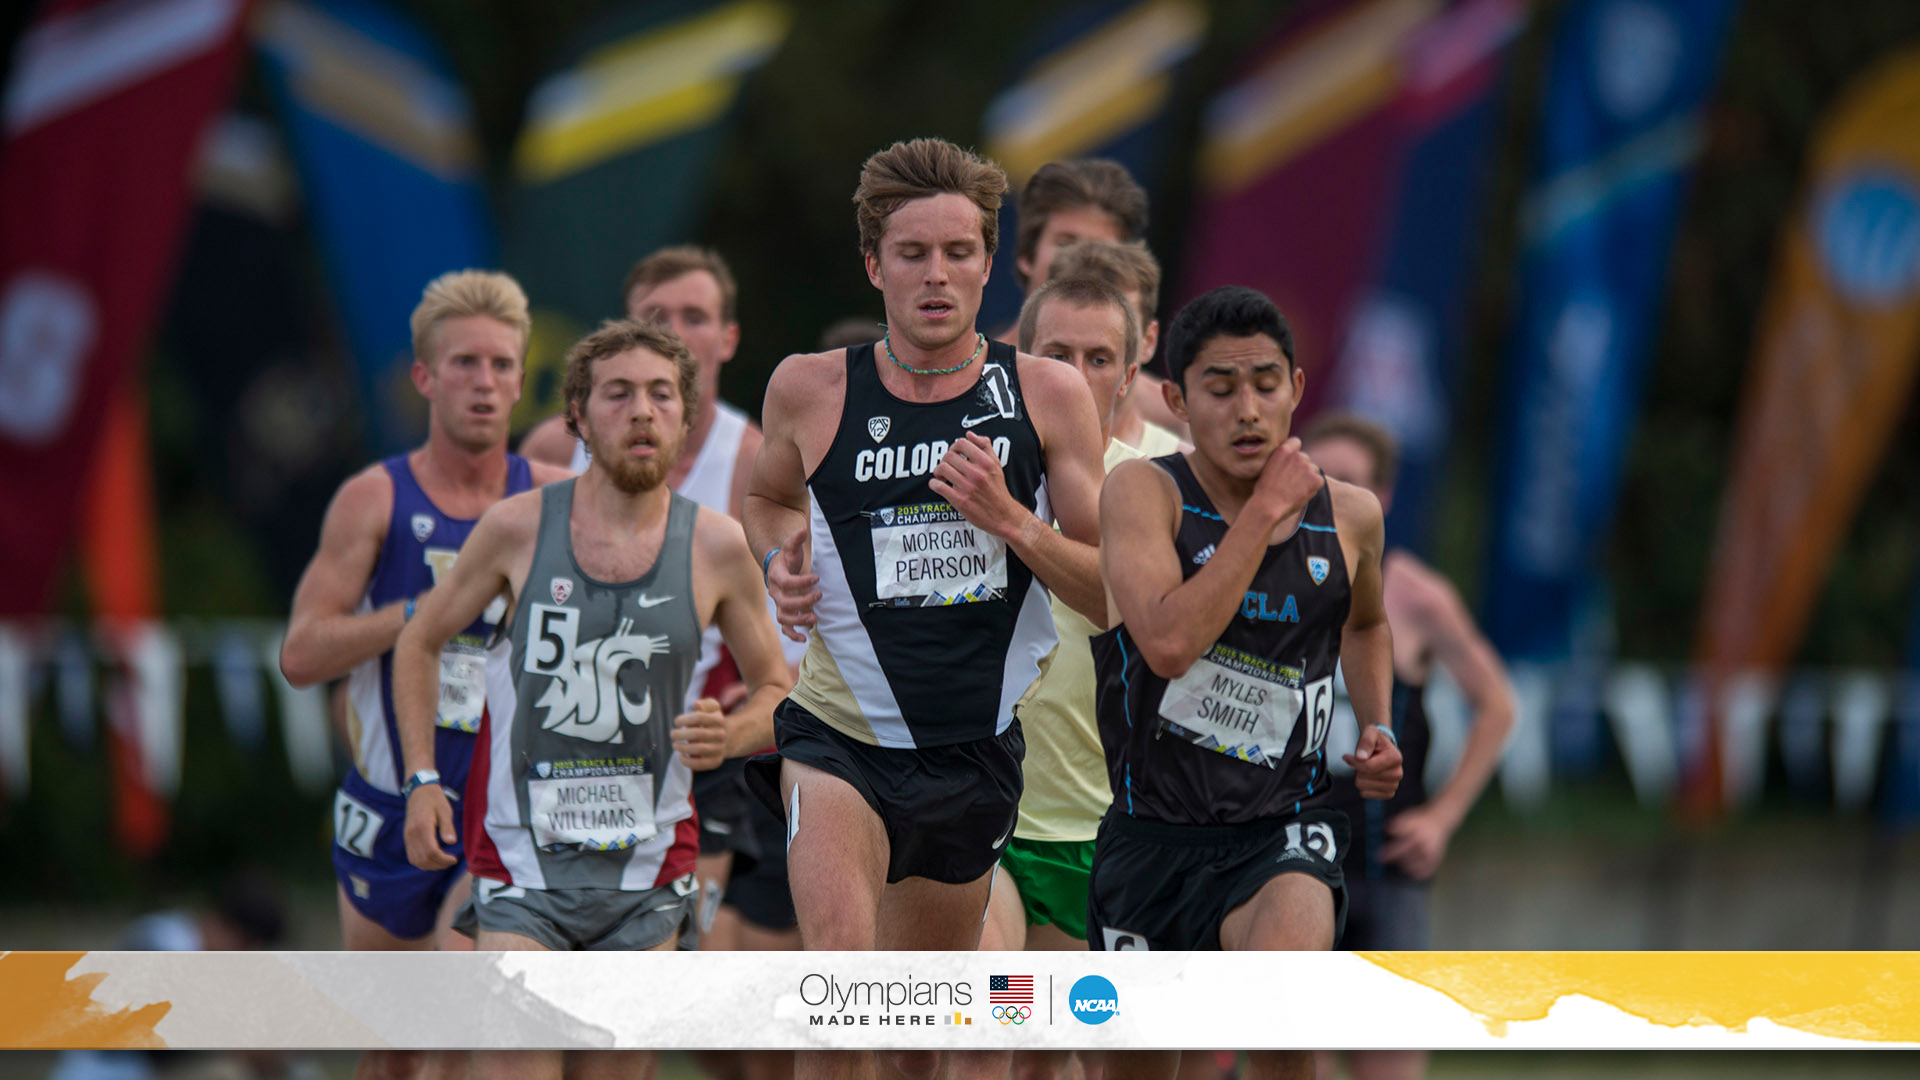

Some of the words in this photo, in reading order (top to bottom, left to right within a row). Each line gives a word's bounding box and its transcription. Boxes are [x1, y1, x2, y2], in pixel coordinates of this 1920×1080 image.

[984, 366, 1013, 414] 1
[854, 436, 1010, 483] COLORO
[897, 506, 919, 516] 2015
[921, 503, 952, 513] TRACK
[897, 511, 966, 525] CHAMPIONS
[902, 529, 975, 552] MORGAN
[896, 554, 986, 582] PEARSON
[1241, 591, 1300, 623] CLA
[536, 610, 567, 670] 5
[1211, 653, 1300, 689] CHAMPIONSHIPS
[1214, 645, 1237, 659] 2015
[1239, 654, 1268, 670] TRACK
[1280, 667, 1300, 679] FIELD
[1211, 674, 1268, 706] MYLES
[1197, 697, 1259, 734] SMITH
[1311, 684, 1327, 750] 6
[552, 765, 644, 778] CHAMPIONSHIPS
[557, 784, 626, 805] MICHAEL
[342, 804, 368, 856] 12
[547, 807, 636, 831] WILLIAMS
